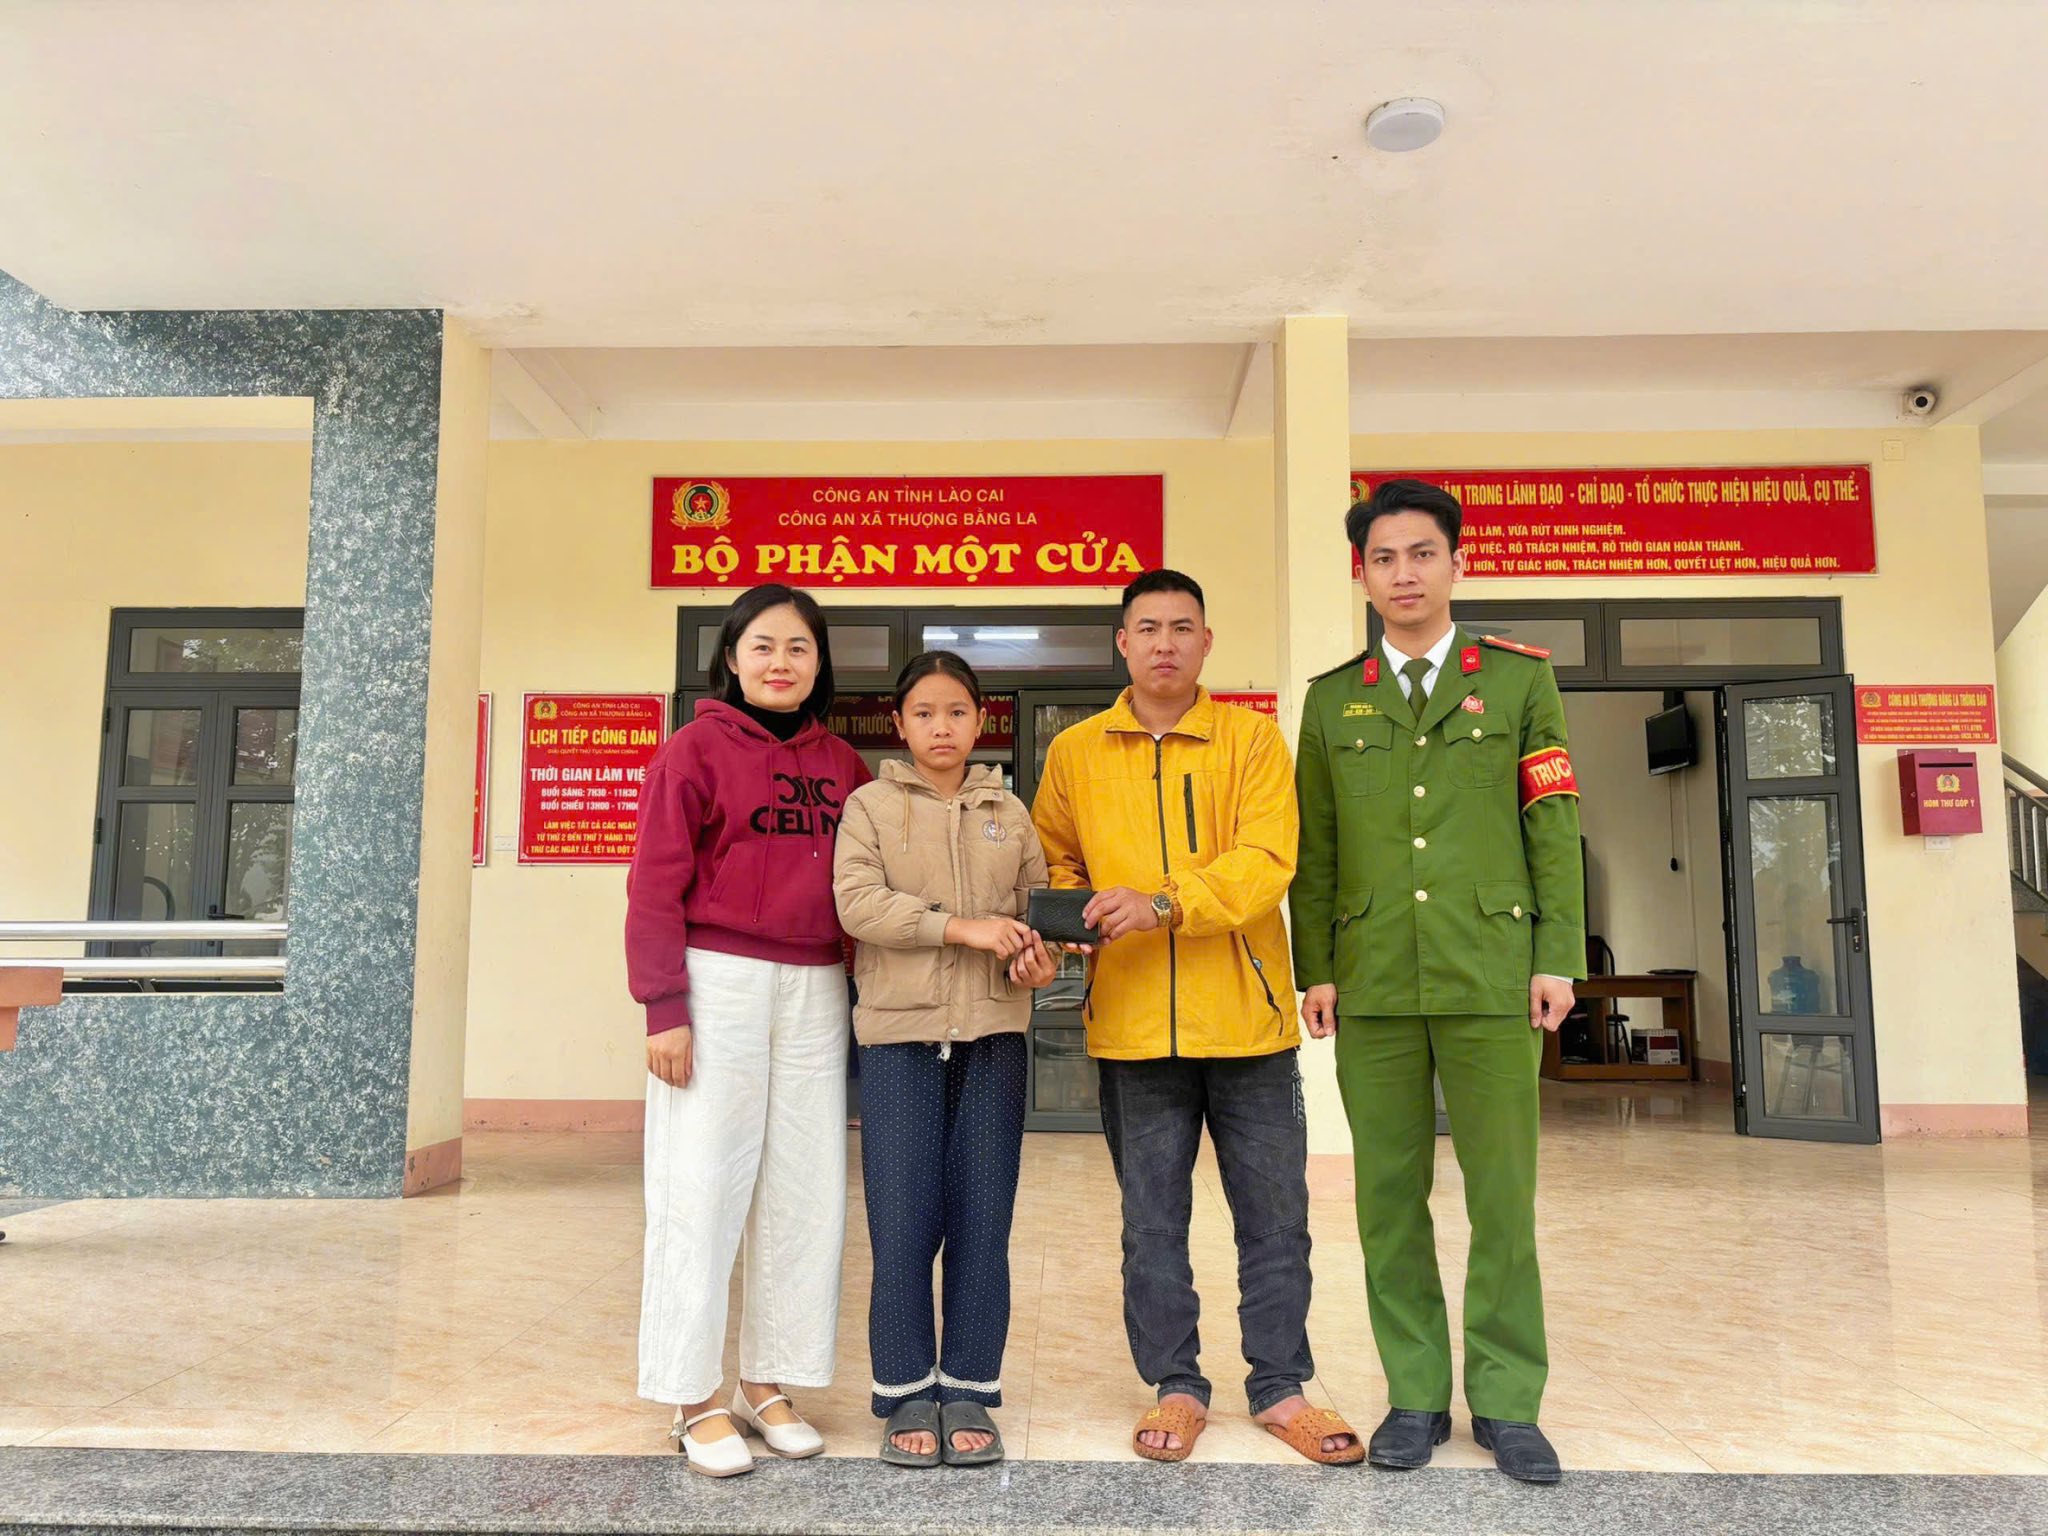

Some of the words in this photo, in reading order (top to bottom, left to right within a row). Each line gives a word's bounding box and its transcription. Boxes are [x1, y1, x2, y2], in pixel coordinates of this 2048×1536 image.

[812, 487, 860, 503] CÔNG
[866, 490, 889, 503] AN
[894, 485, 933, 503] TỈNH
[938, 486, 972, 503] LÀO
[976, 489, 1004, 502] CAI
[1440, 480, 1461, 505] ÂM
[1464, 483, 1503, 505] TRONG
[1506, 480, 1536, 505] LÃNH
[1540, 483, 1563, 510] ĐẠO
[1578, 476, 1597, 504] CHỈ
[1600, 482, 1624, 509] ĐẠO
[1635, 474, 1649, 504] TỔ
[1653, 477, 1684, 504] CHỨC
[1687, 480, 1718, 508] THỰC
[1721, 476, 1749, 507] HIỆN
[1752, 476, 1780, 507] HIỆU
[1783, 473, 1811, 504] QUẢ,
[1814, 480, 1830, 506] CỤ
[1833, 471, 1859, 501] THỂ:
[778, 510, 827, 526] CÔNG
[832, 513, 855, 526] AN
[860, 511, 883, 526] XÃ
[888, 512, 958, 528] THƯỢNG
[963, 508, 1011, 525] BẰNG
[1016, 512, 1038, 525] LA
[1479, 524, 1505, 538] LÀM,
[1508, 523, 1529, 536] VỪA
[1531, 523, 1551, 536] RÚT
[1553, 525, 1579, 536] KINH
[1581, 522, 1626, 538] NGHIỆM.
[671, 535, 740, 583] BỘ
[755, 535, 898, 583] PHẬN
[913, 535, 1021, 582] MỘT
[1036, 530, 1145, 573] CỬA
[1479, 541, 1505, 555] VIỆC,
[1508, 541, 1523, 553] RÕ
[1525, 541, 1559, 553] TRÁCH
[1562, 540, 1599, 555] NHIỆM,
[1602, 540, 1616, 553] RÕ
[1619, 538, 1643, 553] THỜI
[1645, 541, 1671, 552] GIAN
[1673, 539, 1703, 552] HOÀN
[1706, 538, 1744, 551] THÀNH.
[1474, 559, 1498, 572] HƠN,
[1501, 559, 1515, 574] TỰ
[1517, 559, 1541, 571] GIÁC
[1545, 558, 1570, 571] HƠN,
[1573, 558, 1606, 570] TRÁCH
[1609, 557, 1643, 572] NHIỆM
[1646, 558, 1671, 571] HƠN,
[1674, 555, 1707, 570] QUYẾT
[1710, 557, 1731, 571] LIỆT
[1734, 557, 1760, 570] HƠN,
[1762, 555, 1787, 570] HIỆU
[1790, 554, 1812, 568] QUẢ
[1814, 556, 1840, 568] HƠN.
[827, 712, 847, 735] ÀM
[851, 712, 892, 735] THƯỚC
[529, 728, 558, 748] LỊCH
[561, 724, 589, 745] TIẾP
[592, 726, 627, 745] CÔNG
[630, 726, 657, 745] DÂN
[530, 764, 558, 782] THỜI
[562, 768, 592, 782] GIAN
[595, 766, 623, 782] LÀM
[626, 766, 646, 784] VIỆ
[750, 805, 844, 836] CELIN
